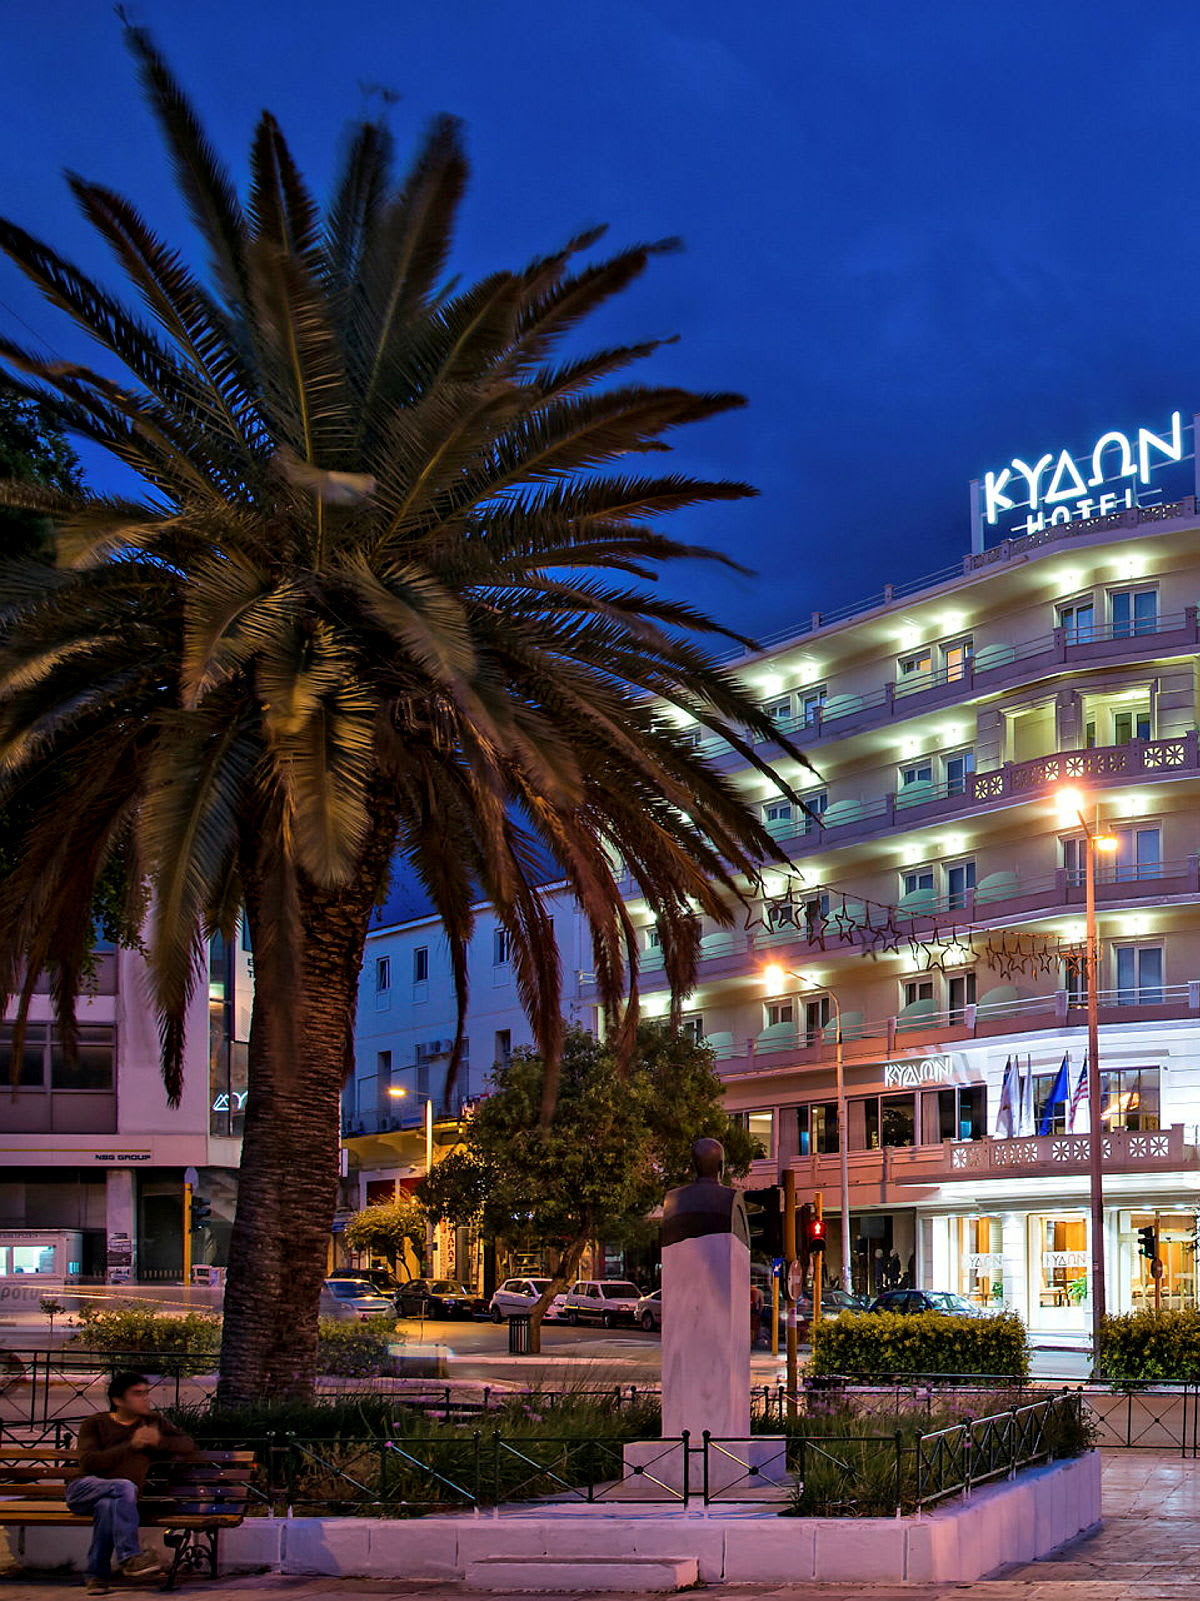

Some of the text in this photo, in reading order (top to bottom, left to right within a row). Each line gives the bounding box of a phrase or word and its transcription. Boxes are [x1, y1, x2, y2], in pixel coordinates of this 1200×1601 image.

[985, 410, 1182, 525] ΚΥΔΩΝ
[884, 1057, 952, 1088] ΚΥΔΩΝ
[965, 1254, 1003, 1268] ΥΔΩΝ
